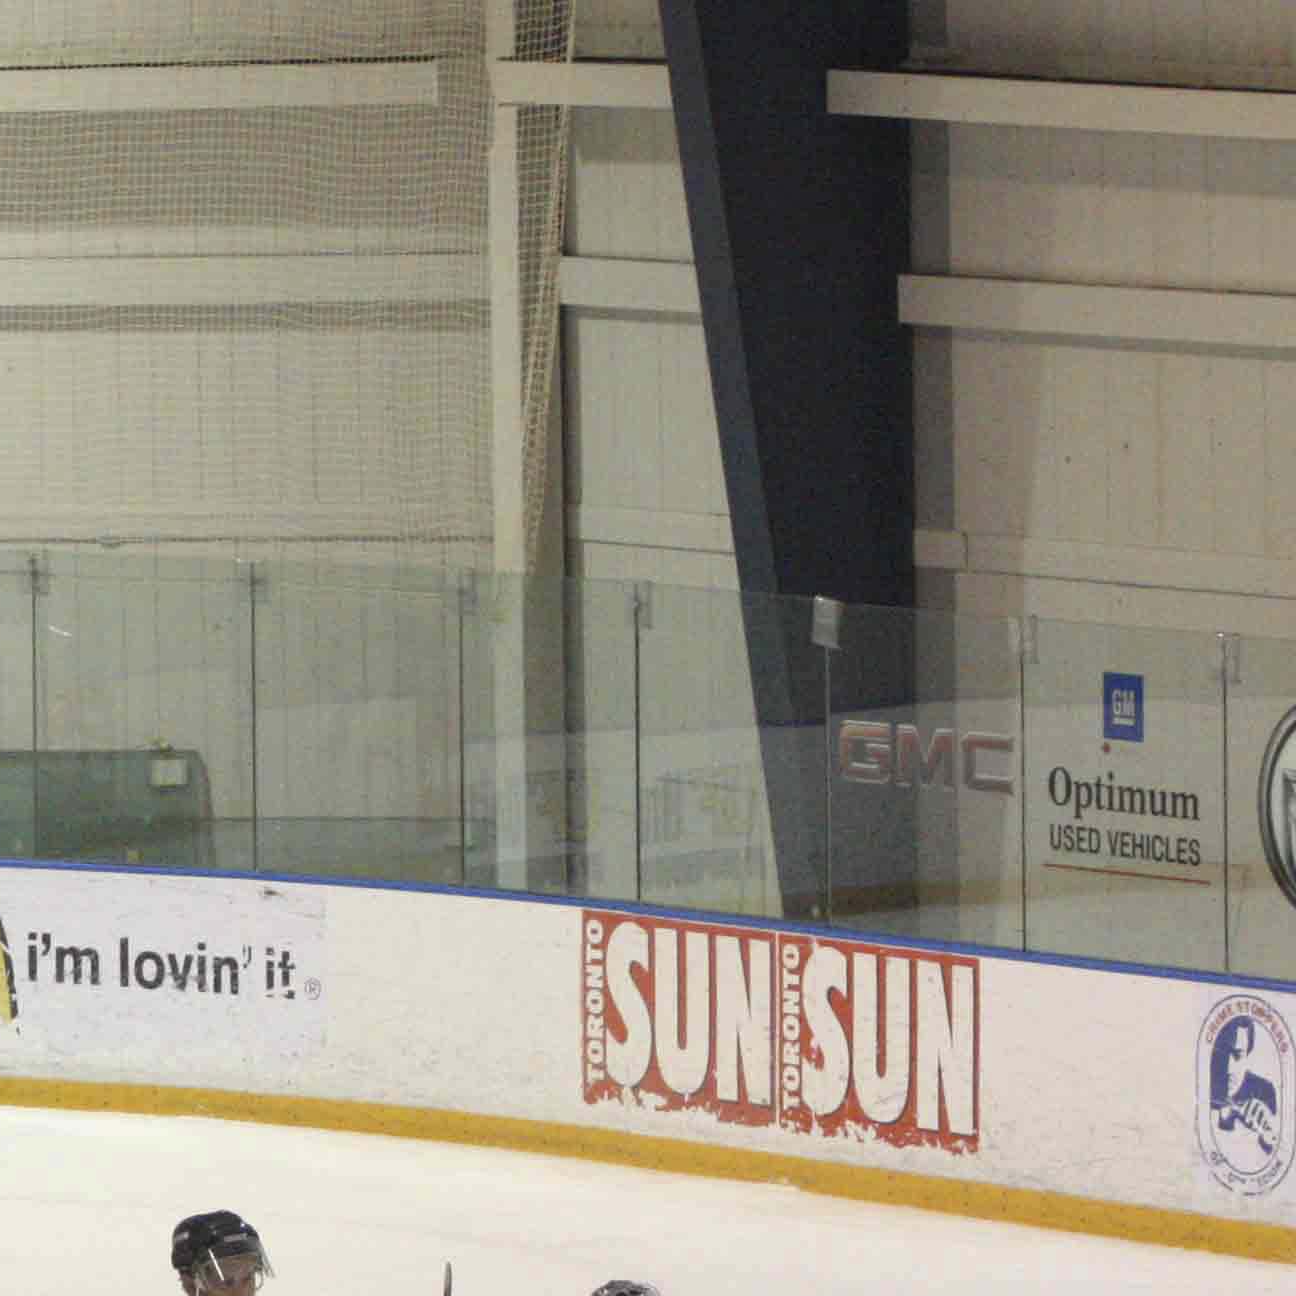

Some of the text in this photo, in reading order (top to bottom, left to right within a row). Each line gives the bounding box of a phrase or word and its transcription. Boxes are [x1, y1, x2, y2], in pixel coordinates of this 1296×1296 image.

[1111, 688, 1136, 718] GM
[838, 719, 1015, 796] GMC
[1048, 766, 1200, 822] Optimum
[1049, 823, 1201, 867] USED VEHICLES
[27, 932, 100, 985] i'm
[119, 937, 251, 995] lovin'
[265, 947, 297, 999] it
[584, 919, 606, 1087] TORONTO
[606, 921, 775, 1108] SUN
[780, 943, 801, 1112] TORONTO
[805, 942, 978, 1137] SUN
